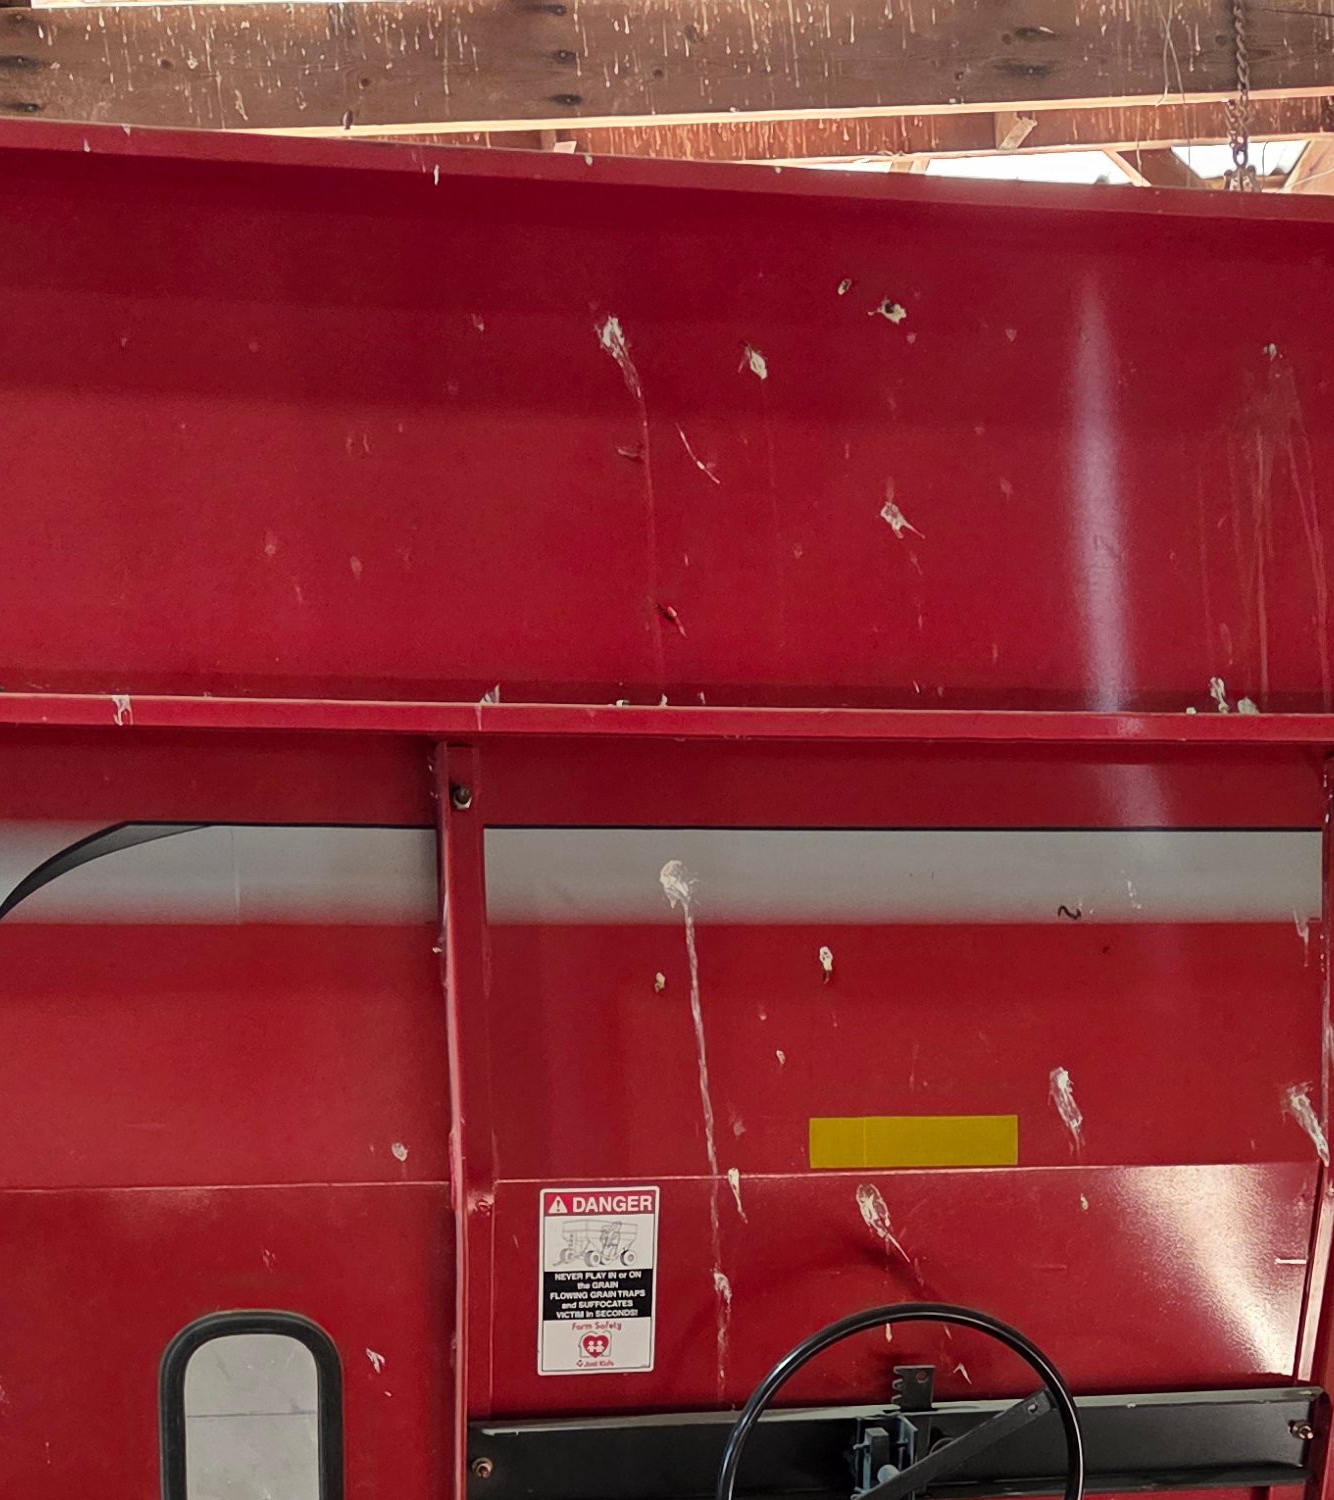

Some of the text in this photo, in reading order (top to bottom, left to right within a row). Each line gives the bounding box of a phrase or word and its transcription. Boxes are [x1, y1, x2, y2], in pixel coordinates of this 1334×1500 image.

[572, 1195, 652, 1213] DANGER
[554, 1272, 584, 1281] NEVER
[585, 1272, 606, 1280] PLAY
[608, 1271, 617, 1279] IN
[628, 1270, 642, 1279] ON
[577, 1281, 619, 1290] the GRAIN
[549, 1289, 646, 1300] FLOWING GRAIN TRAPS
[561, 1300, 634, 1309] and SUFFOCATES
[556, 1309, 638, 1319] VICTIM in SECONDS!
[571, 1321, 622, 1331] Farm Safety
